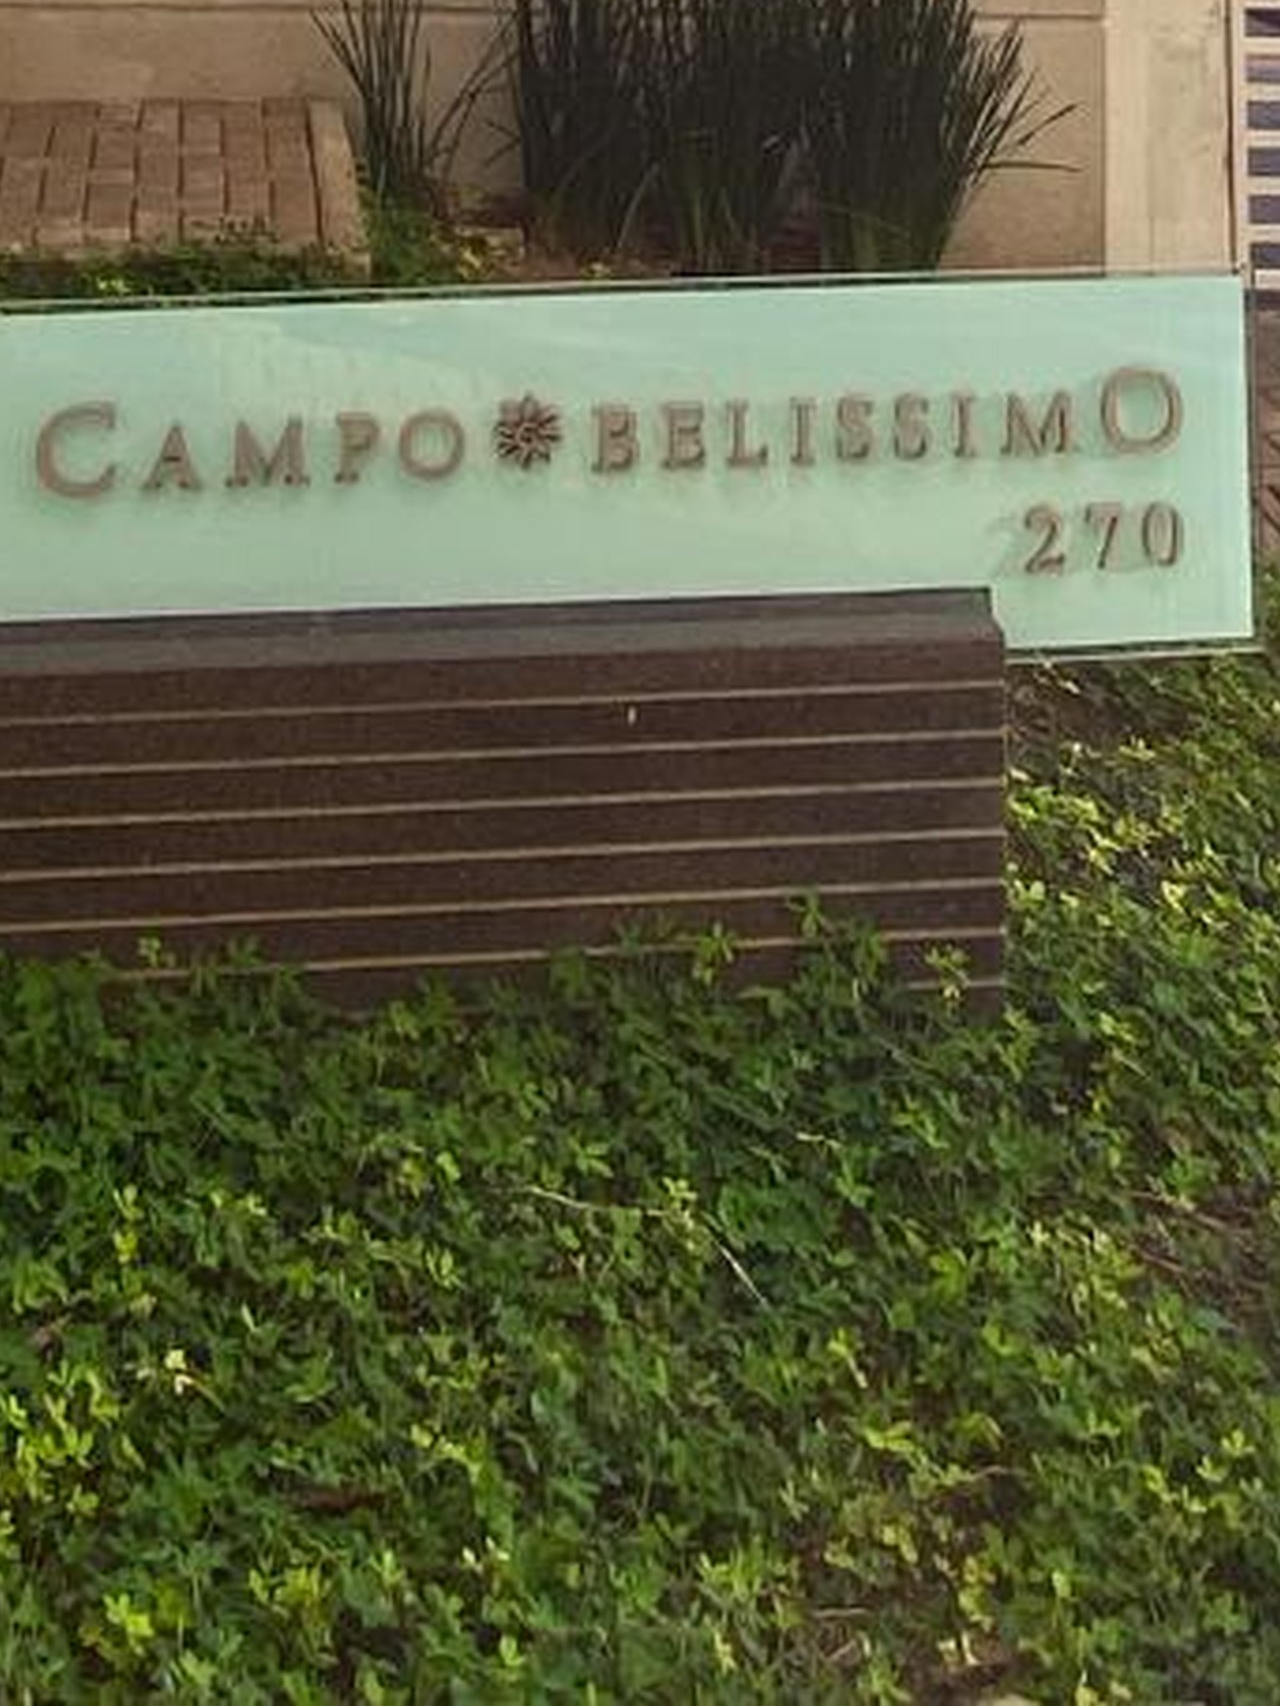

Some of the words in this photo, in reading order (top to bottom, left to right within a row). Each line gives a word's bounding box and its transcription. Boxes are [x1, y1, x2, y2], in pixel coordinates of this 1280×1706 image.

[33, 400, 466, 500] CAMPO
[589, 363, 1184, 475] BELISSIMO
[1022, 502, 1185, 575] 270
